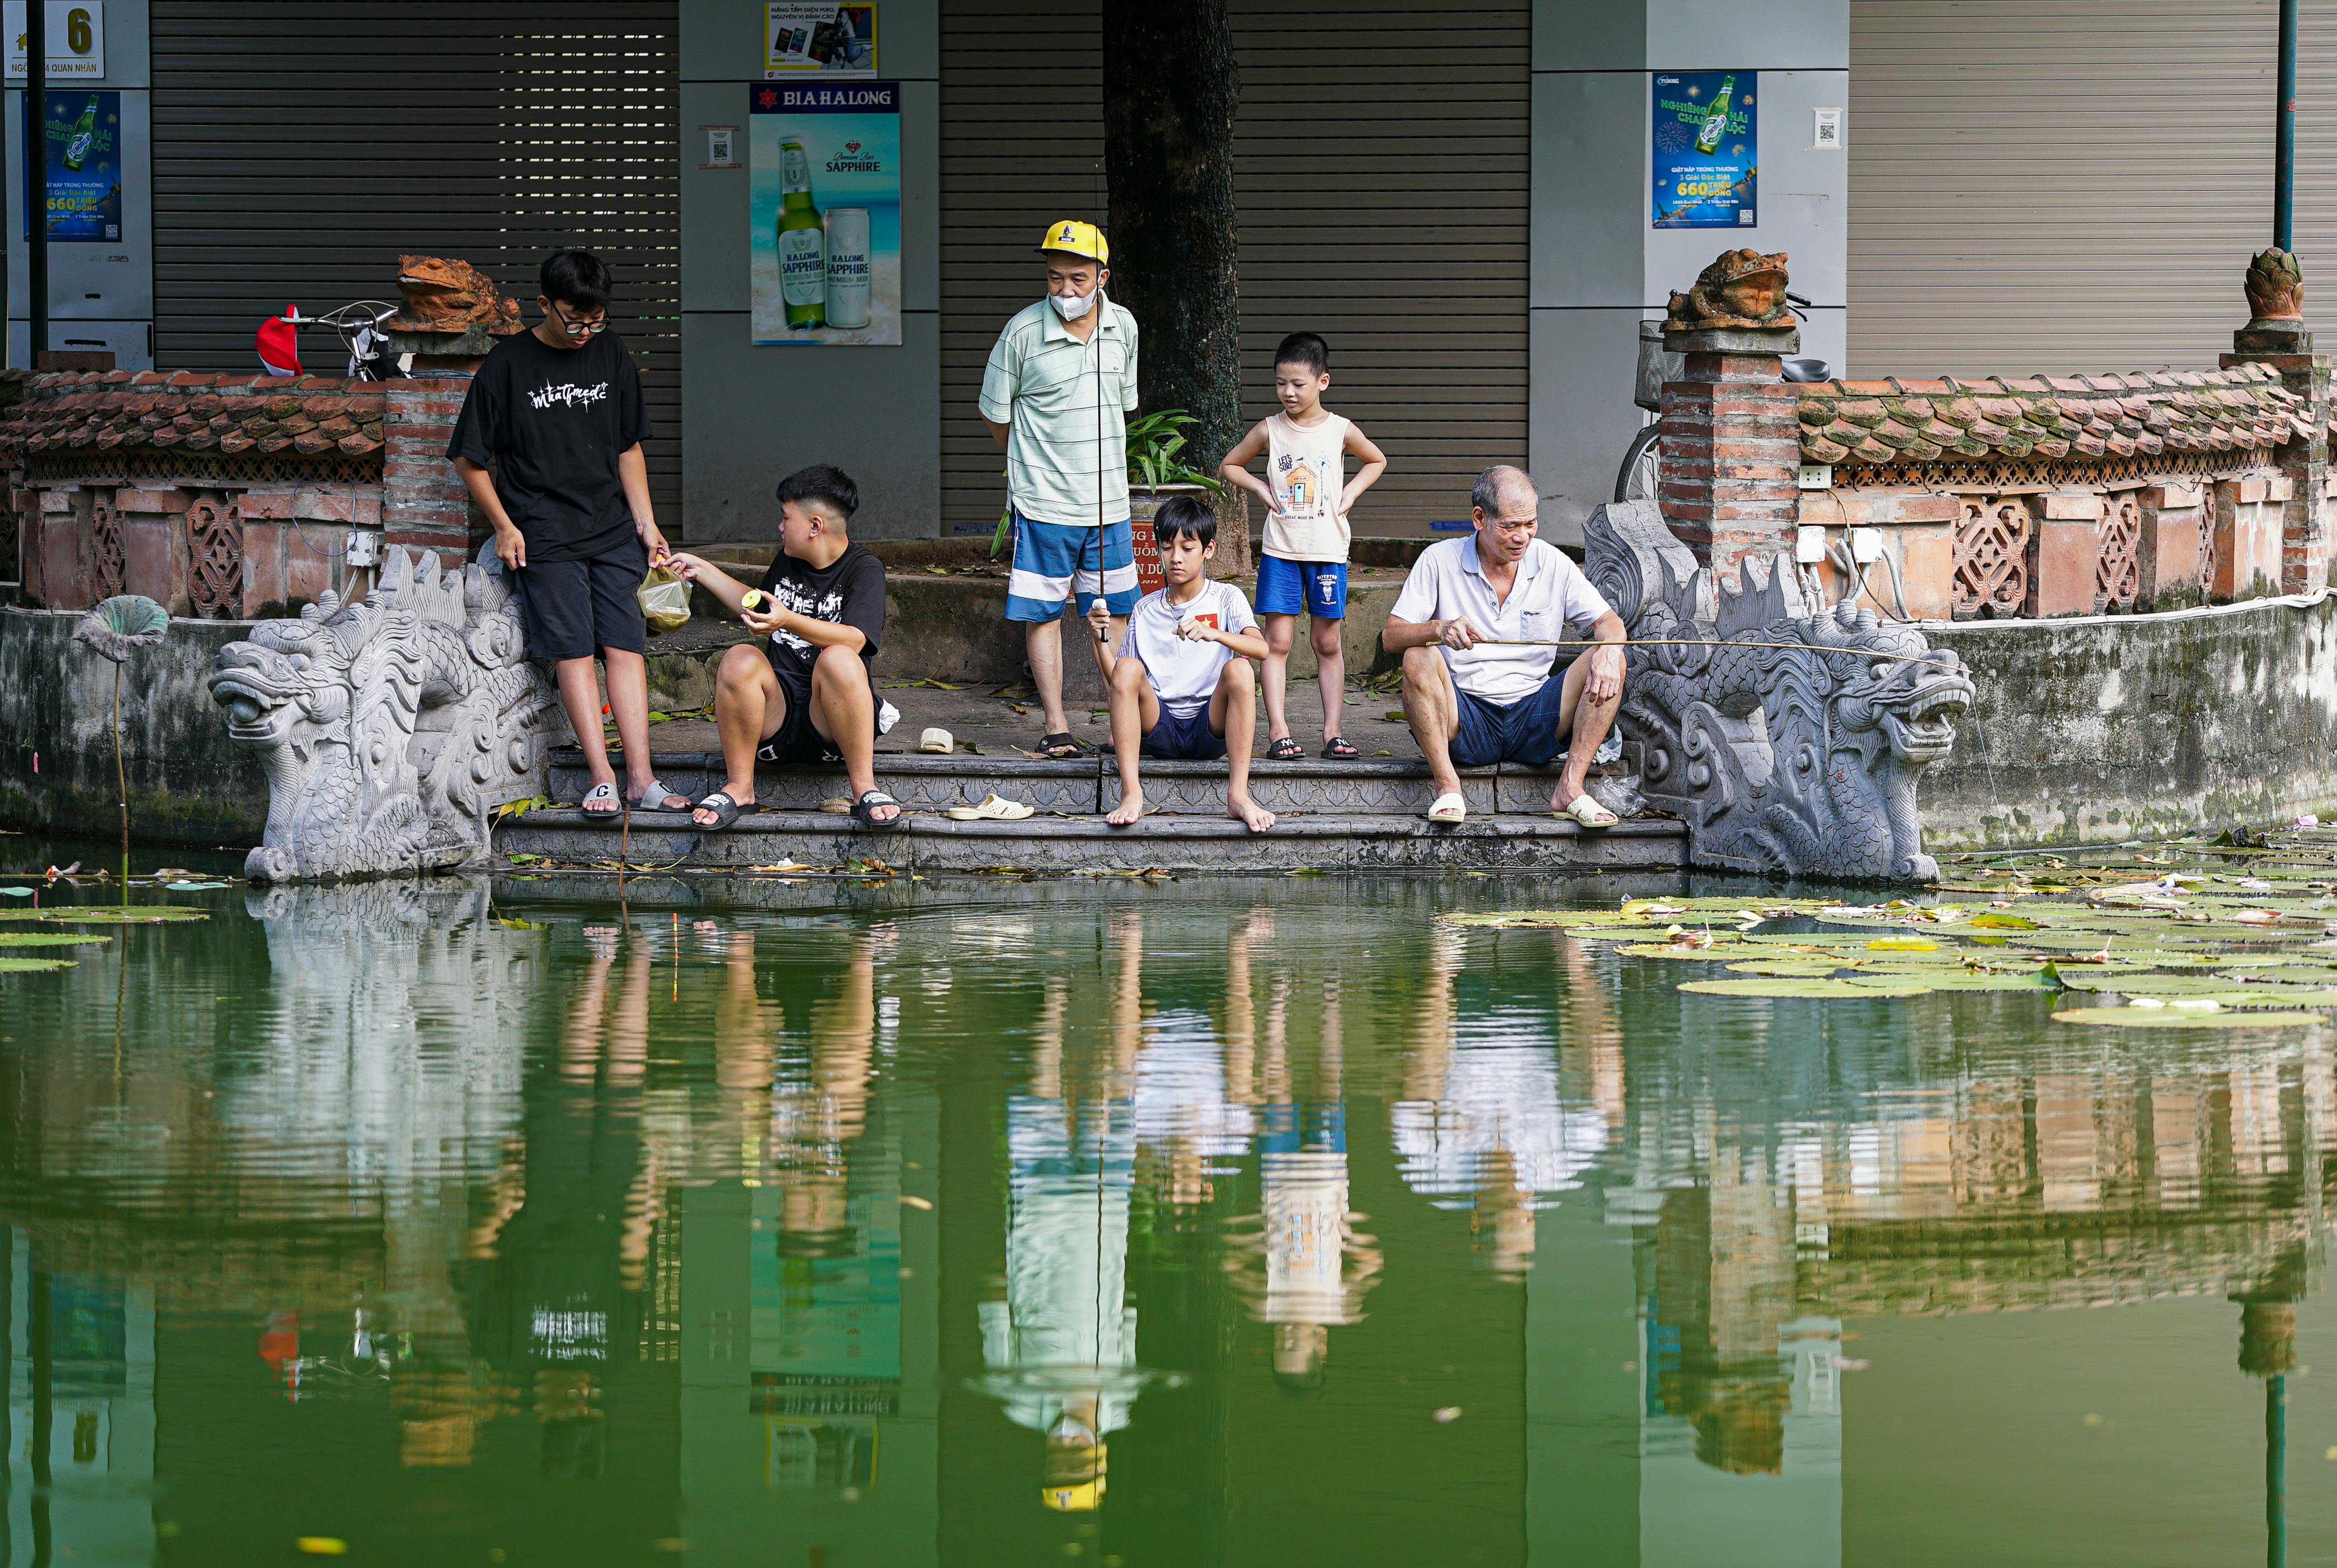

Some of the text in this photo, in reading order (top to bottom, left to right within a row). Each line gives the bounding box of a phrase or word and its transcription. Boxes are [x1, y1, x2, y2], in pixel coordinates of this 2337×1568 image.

[68, 8, 91, 54] 6
[52, 64, 73, 72] QUAN
[783, 91, 816, 105] BIA
[1661, 99, 1707, 116] NGHIÊNG
[1677, 112, 1705, 125] CHAI
[1701, 120, 1723, 140] TUBORG
[1725, 122, 1746, 135] LỘC
[68, 137, 89, 158] TUBORG
[826, 161, 881, 172] SAPPHIRE
[1677, 182, 1708, 196] 660
[46, 197, 76, 211] 660
[782, 259, 825, 274] SAPPHIRE
[827, 263, 869, 274] SAPPHIRE
[1278, 462, 1293, 472] SURF
[596, 785, 610, 797] G
